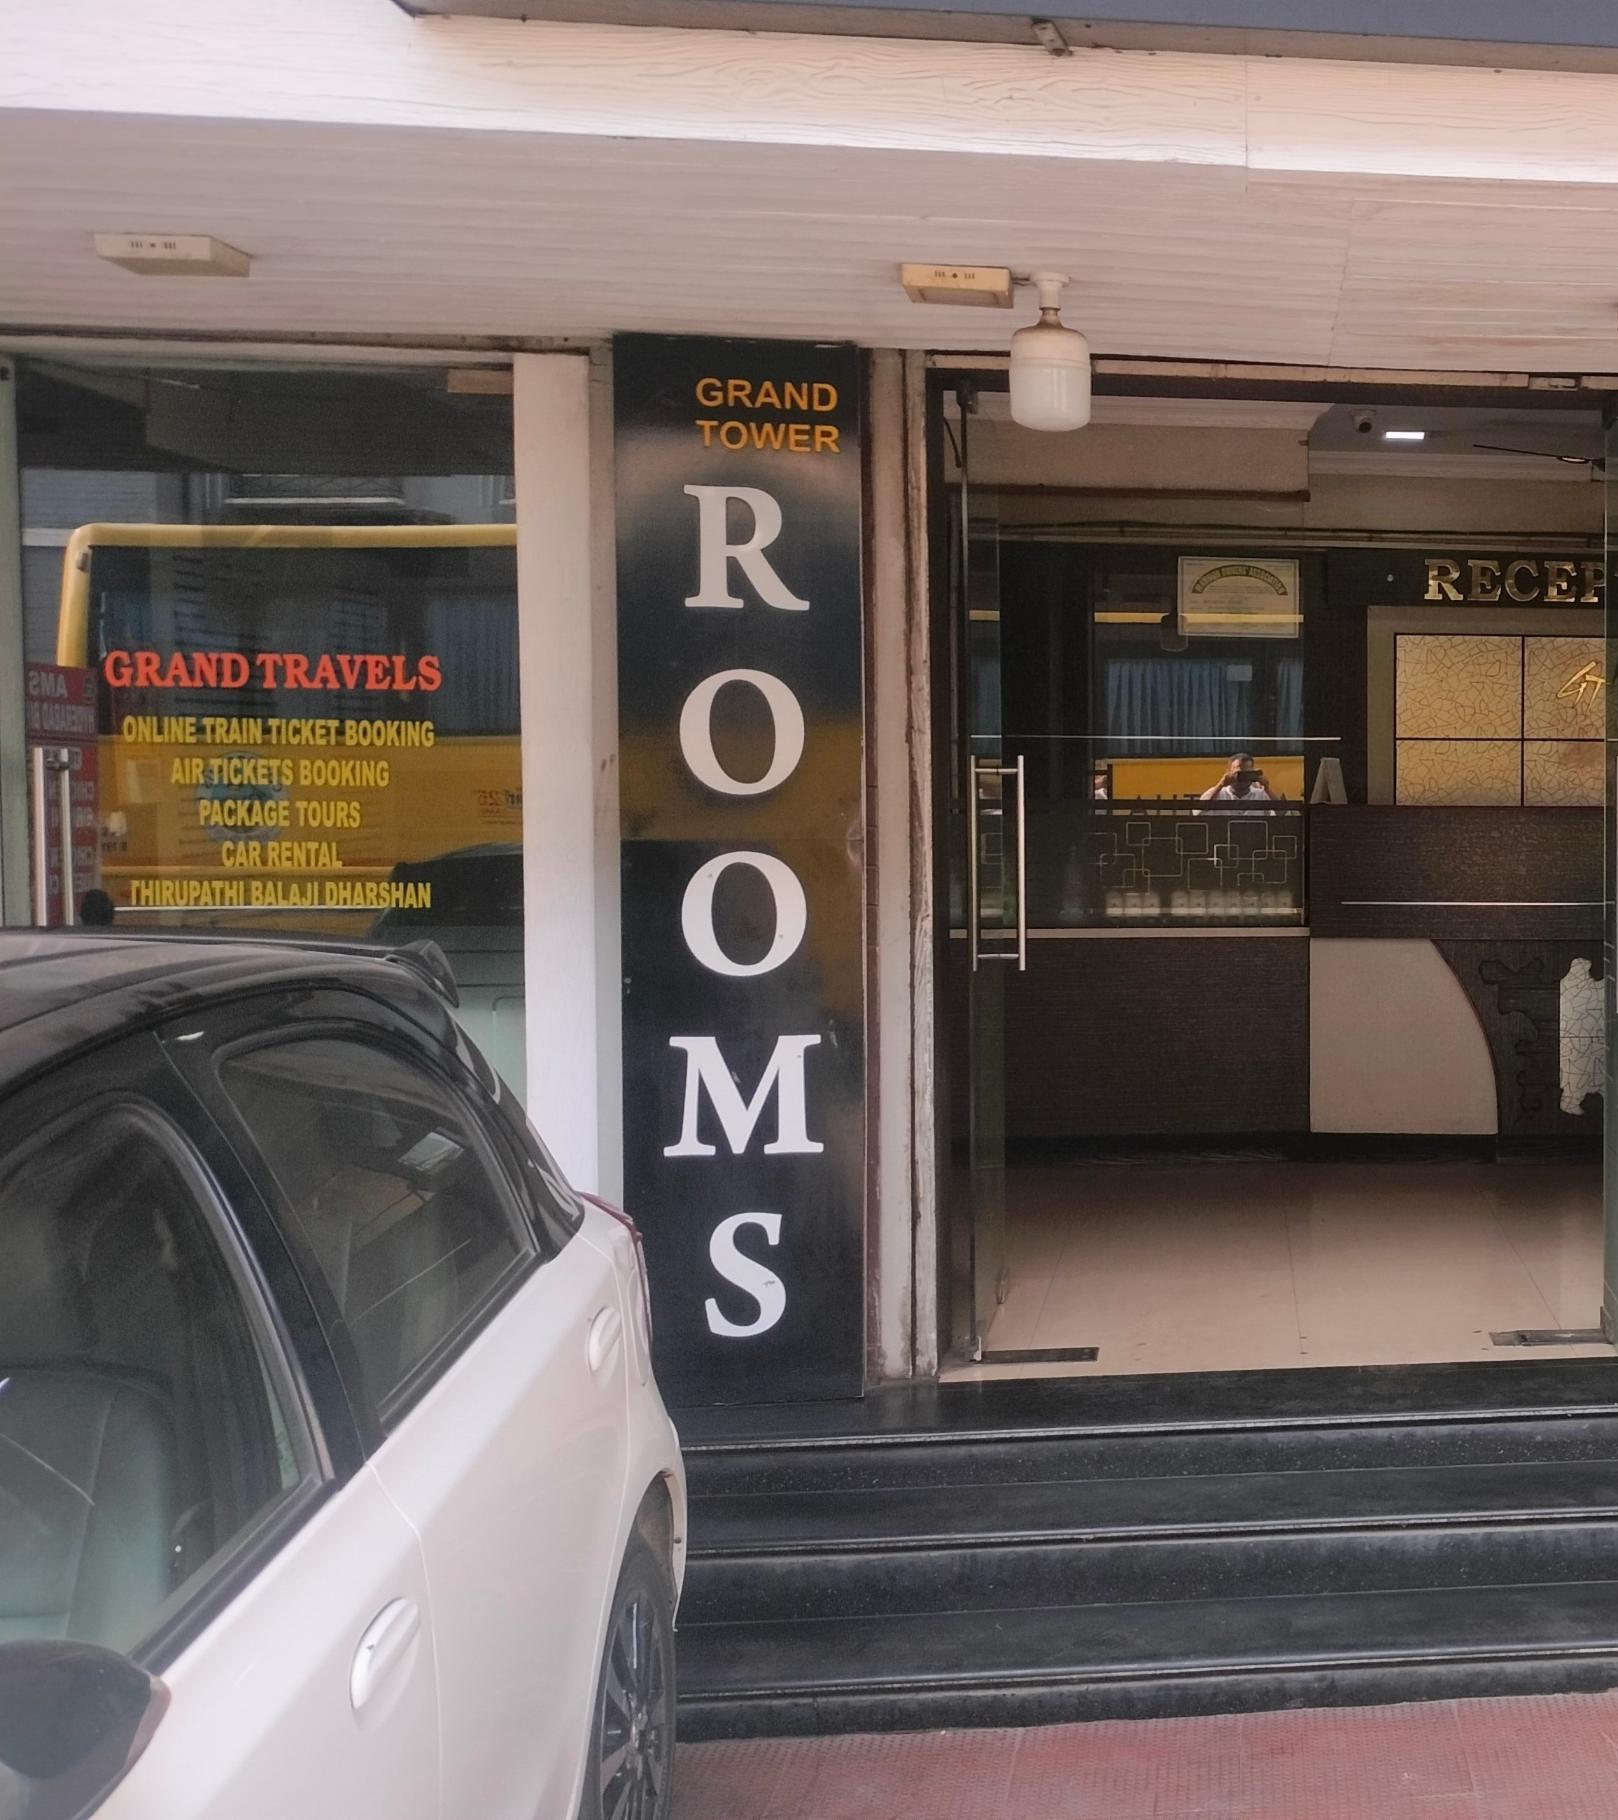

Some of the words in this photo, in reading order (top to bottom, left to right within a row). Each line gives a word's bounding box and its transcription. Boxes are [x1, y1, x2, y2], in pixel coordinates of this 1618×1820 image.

[695, 378, 838, 411] GRAND
[695, 420, 841, 453] TOWER
[104, 650, 250, 688] GRAND
[257, 654, 443, 692] TRAVELS
[122, 715, 197, 744] ONLINE
[203, 717, 262, 745] TRAIN
[268, 718, 339, 746] TICKET
[345, 720, 435, 747] BOOKING
[171, 758, 204, 785] AIR
[212, 758, 294, 786] TICKETS
[300, 760, 390, 787] BOOKING
[199, 799, 290, 827] PACKAGE
[296, 801, 361, 828] TOURS
[221, 841, 261, 867] CAR
[268, 841, 343, 868] RENTAL
[130, 880, 244, 906] THIRUPATHI
[250, 880, 318, 907] BALAJI
[325, 881, 432, 908] DHARSHAN
[663, 484, 824, 1338] ROOMS
